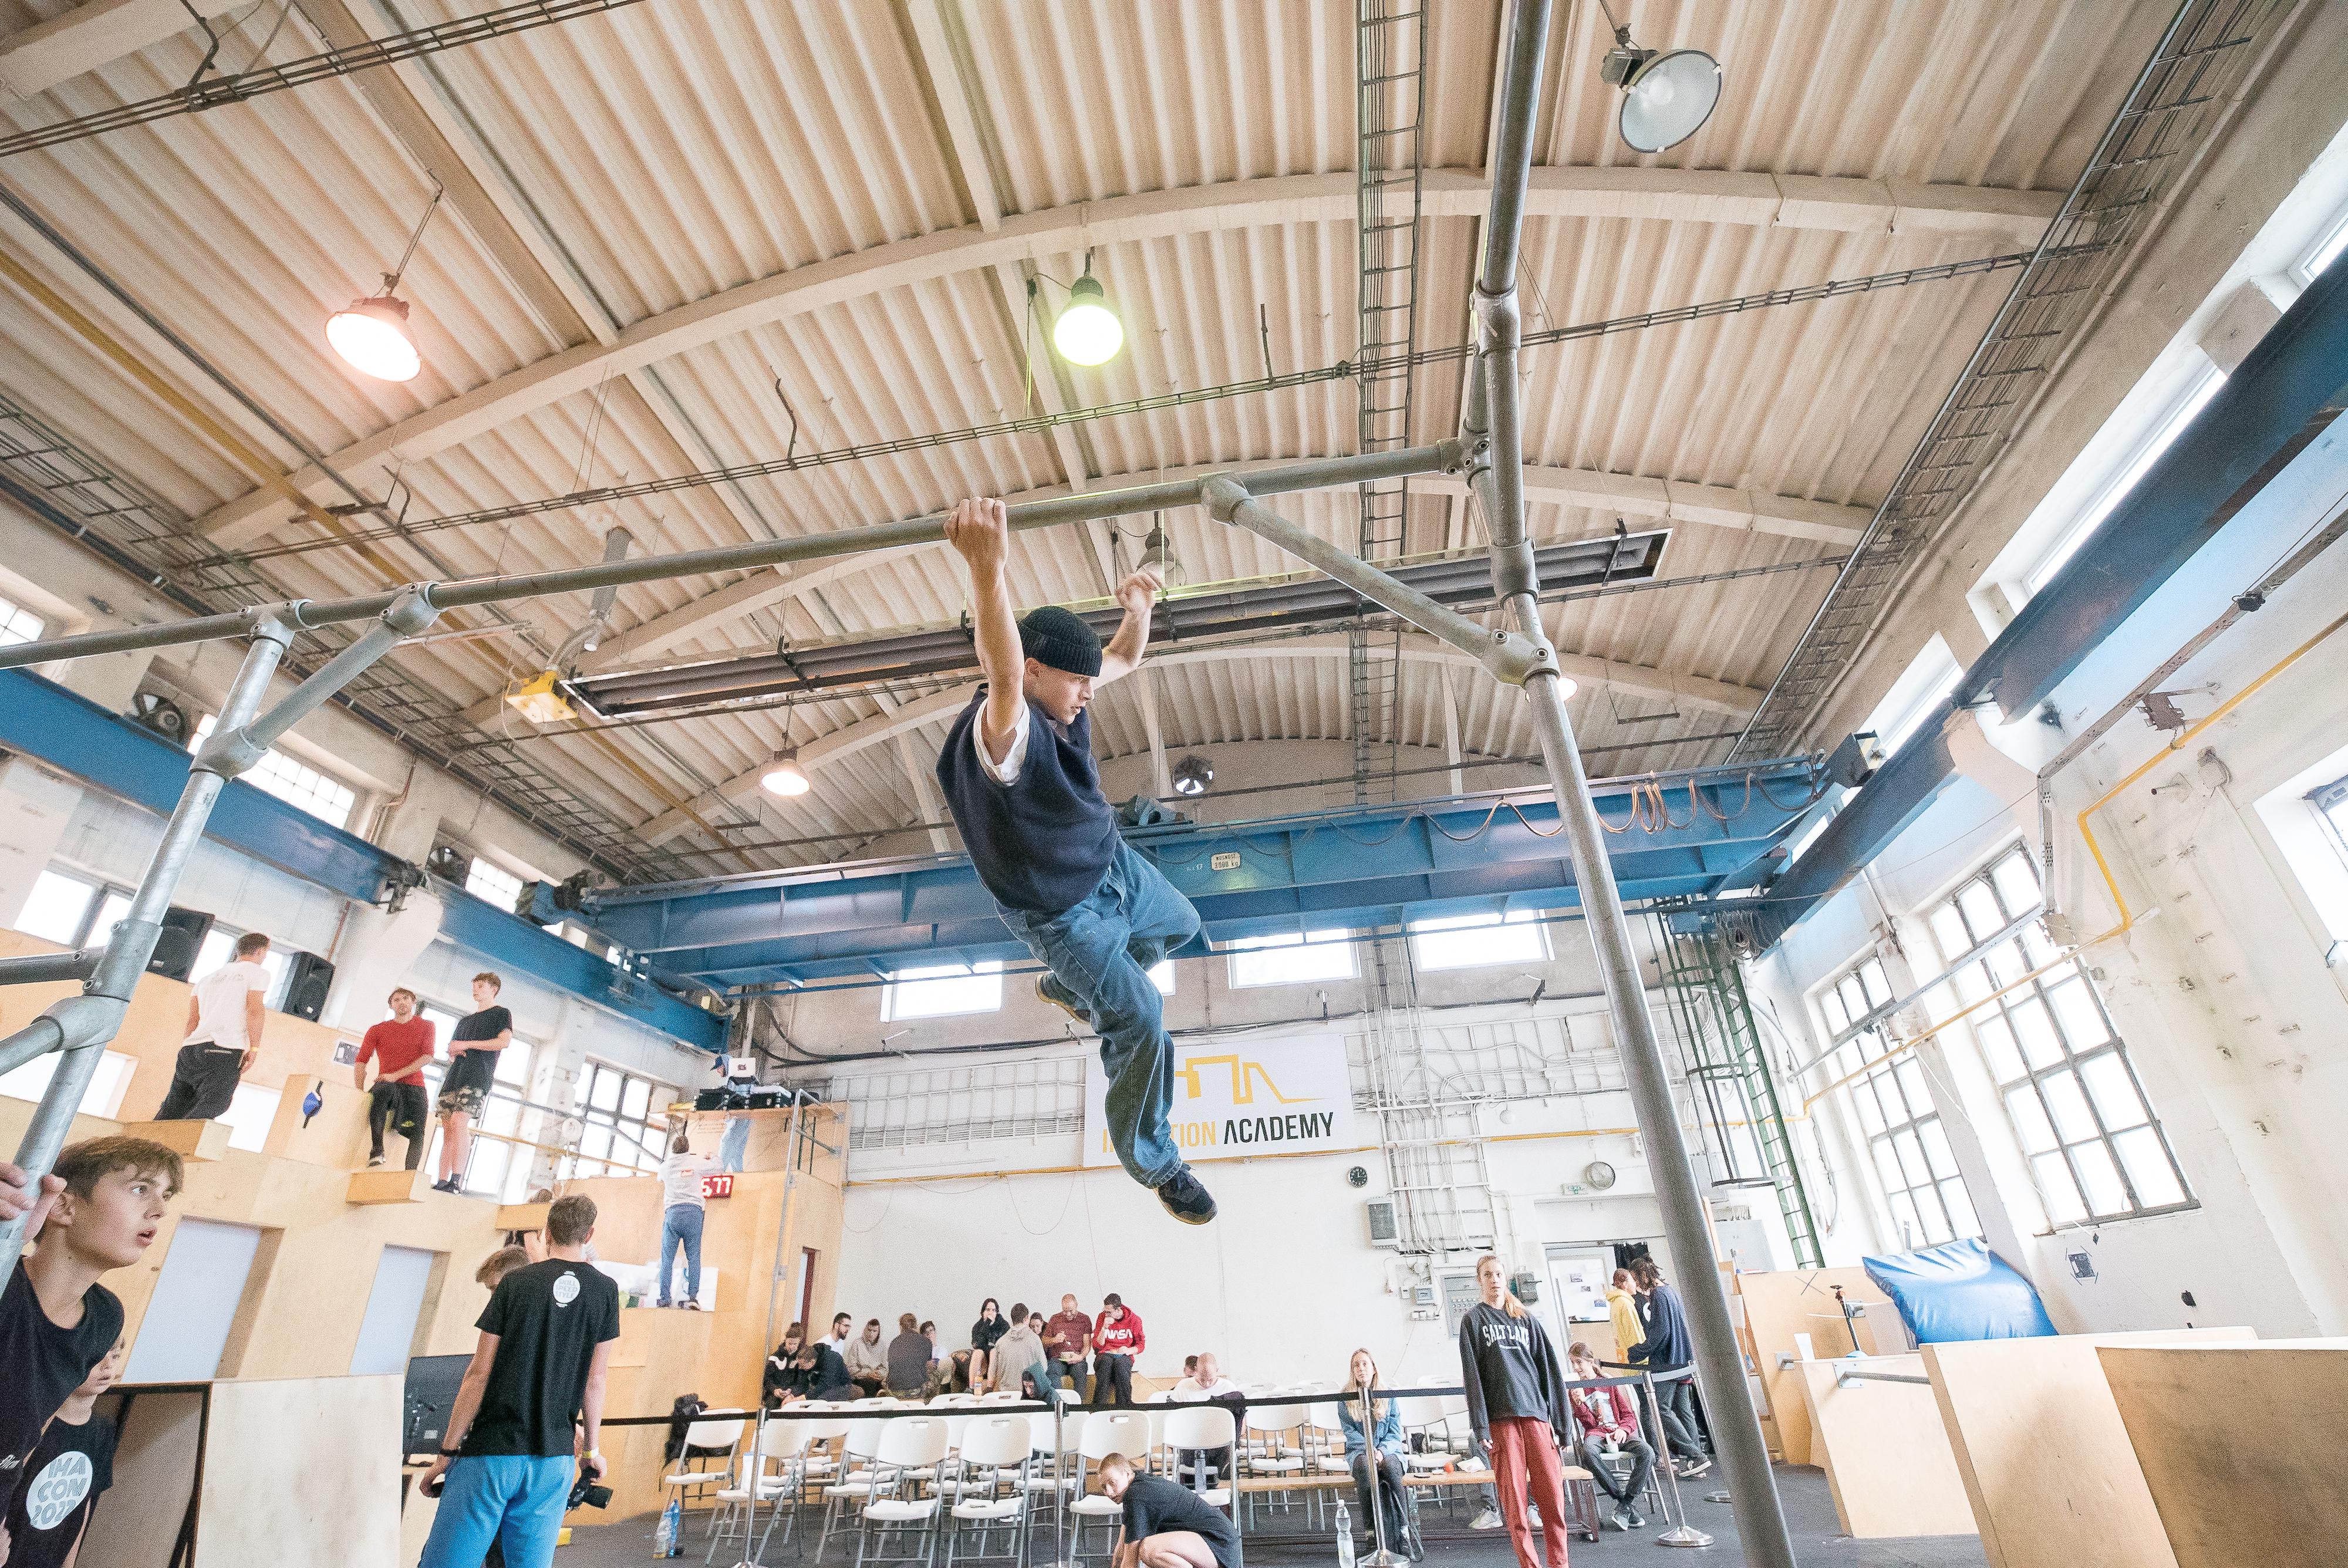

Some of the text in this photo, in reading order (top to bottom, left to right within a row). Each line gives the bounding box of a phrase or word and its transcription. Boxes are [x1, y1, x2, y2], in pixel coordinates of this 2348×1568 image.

[1224, 1112, 1334, 1145] ACADEMY
[555, 1284, 578, 1293] SPEED
[555, 1290, 575, 1299] STYLE
[1104, 1328, 1133, 1340] NASA
[1482, 1324, 1506, 1347] SALT
[38, 1477, 87, 1502] CON
[30, 1499, 76, 1526] 2022
